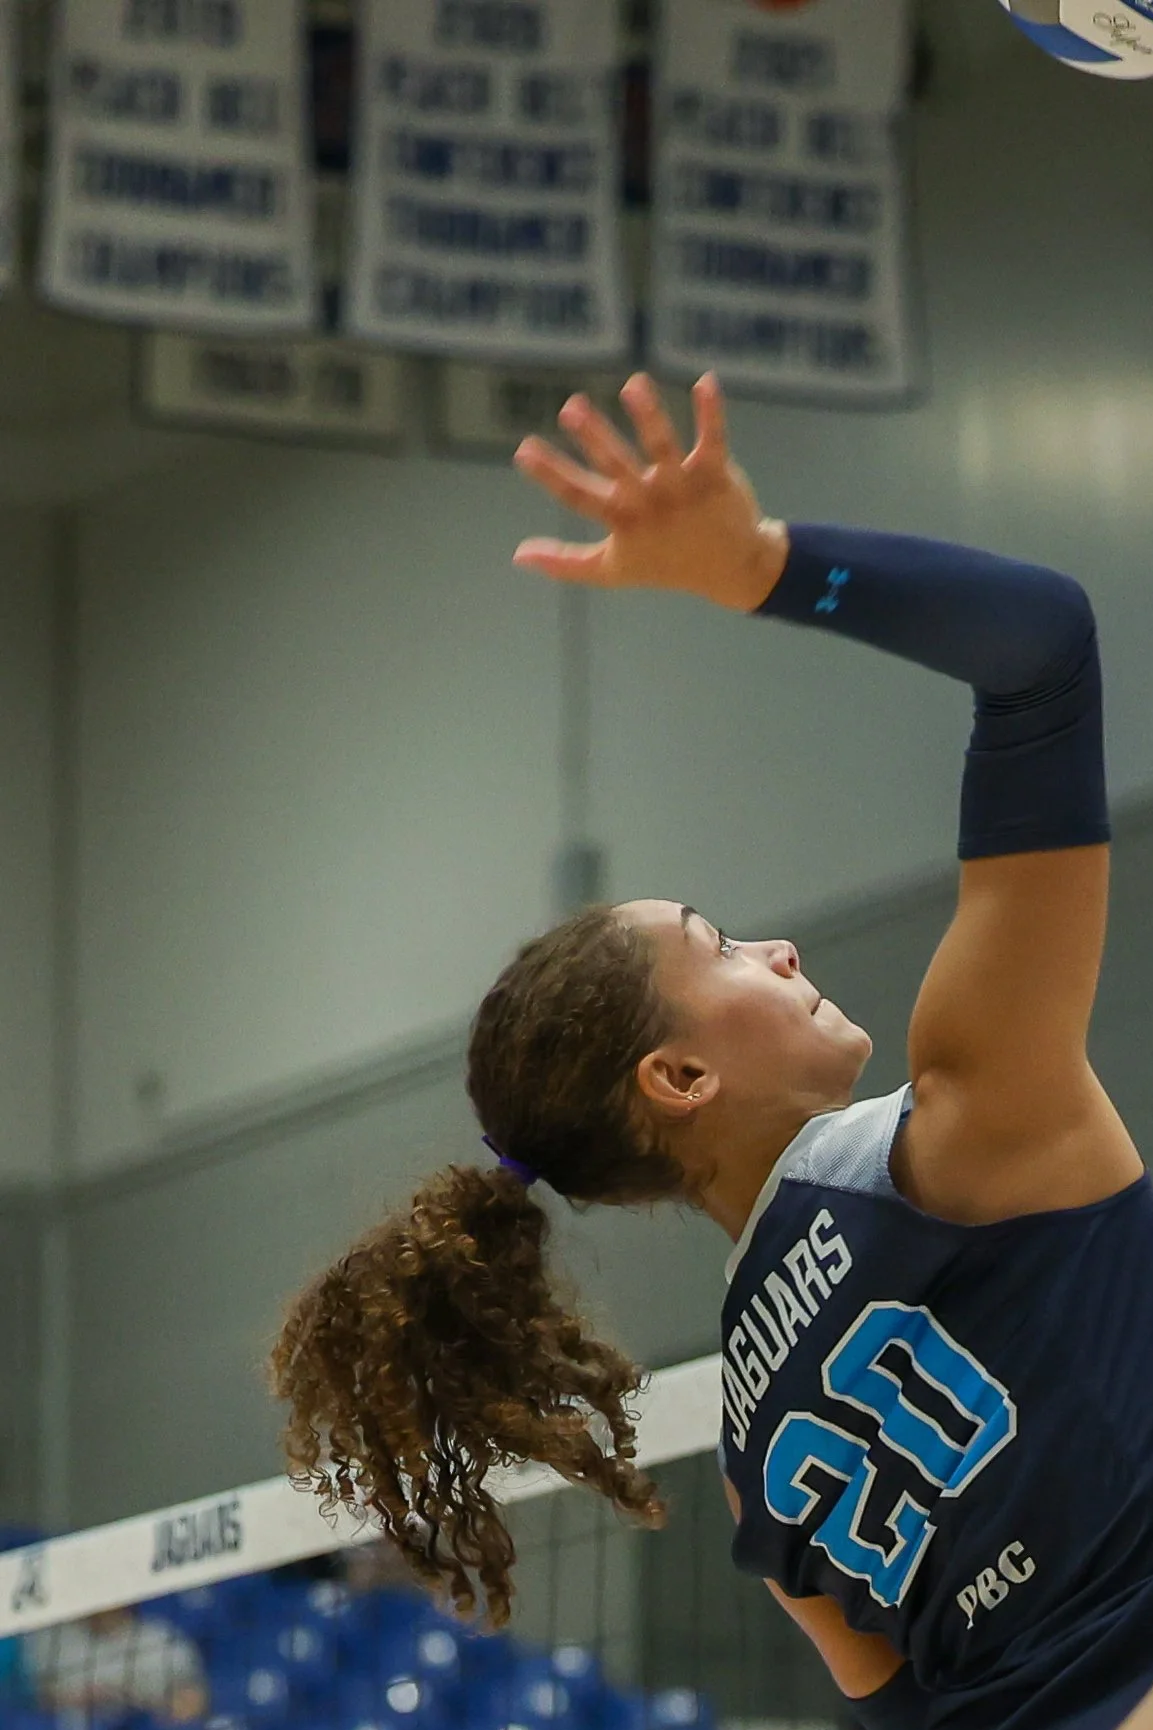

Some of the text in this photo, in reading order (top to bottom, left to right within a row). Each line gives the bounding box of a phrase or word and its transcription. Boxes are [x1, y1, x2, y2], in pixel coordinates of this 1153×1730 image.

[721, 1208, 853, 1453] JAGUARS
[763, 1300, 1018, 1608] 20
[956, 1540, 1036, 1630] PBC
